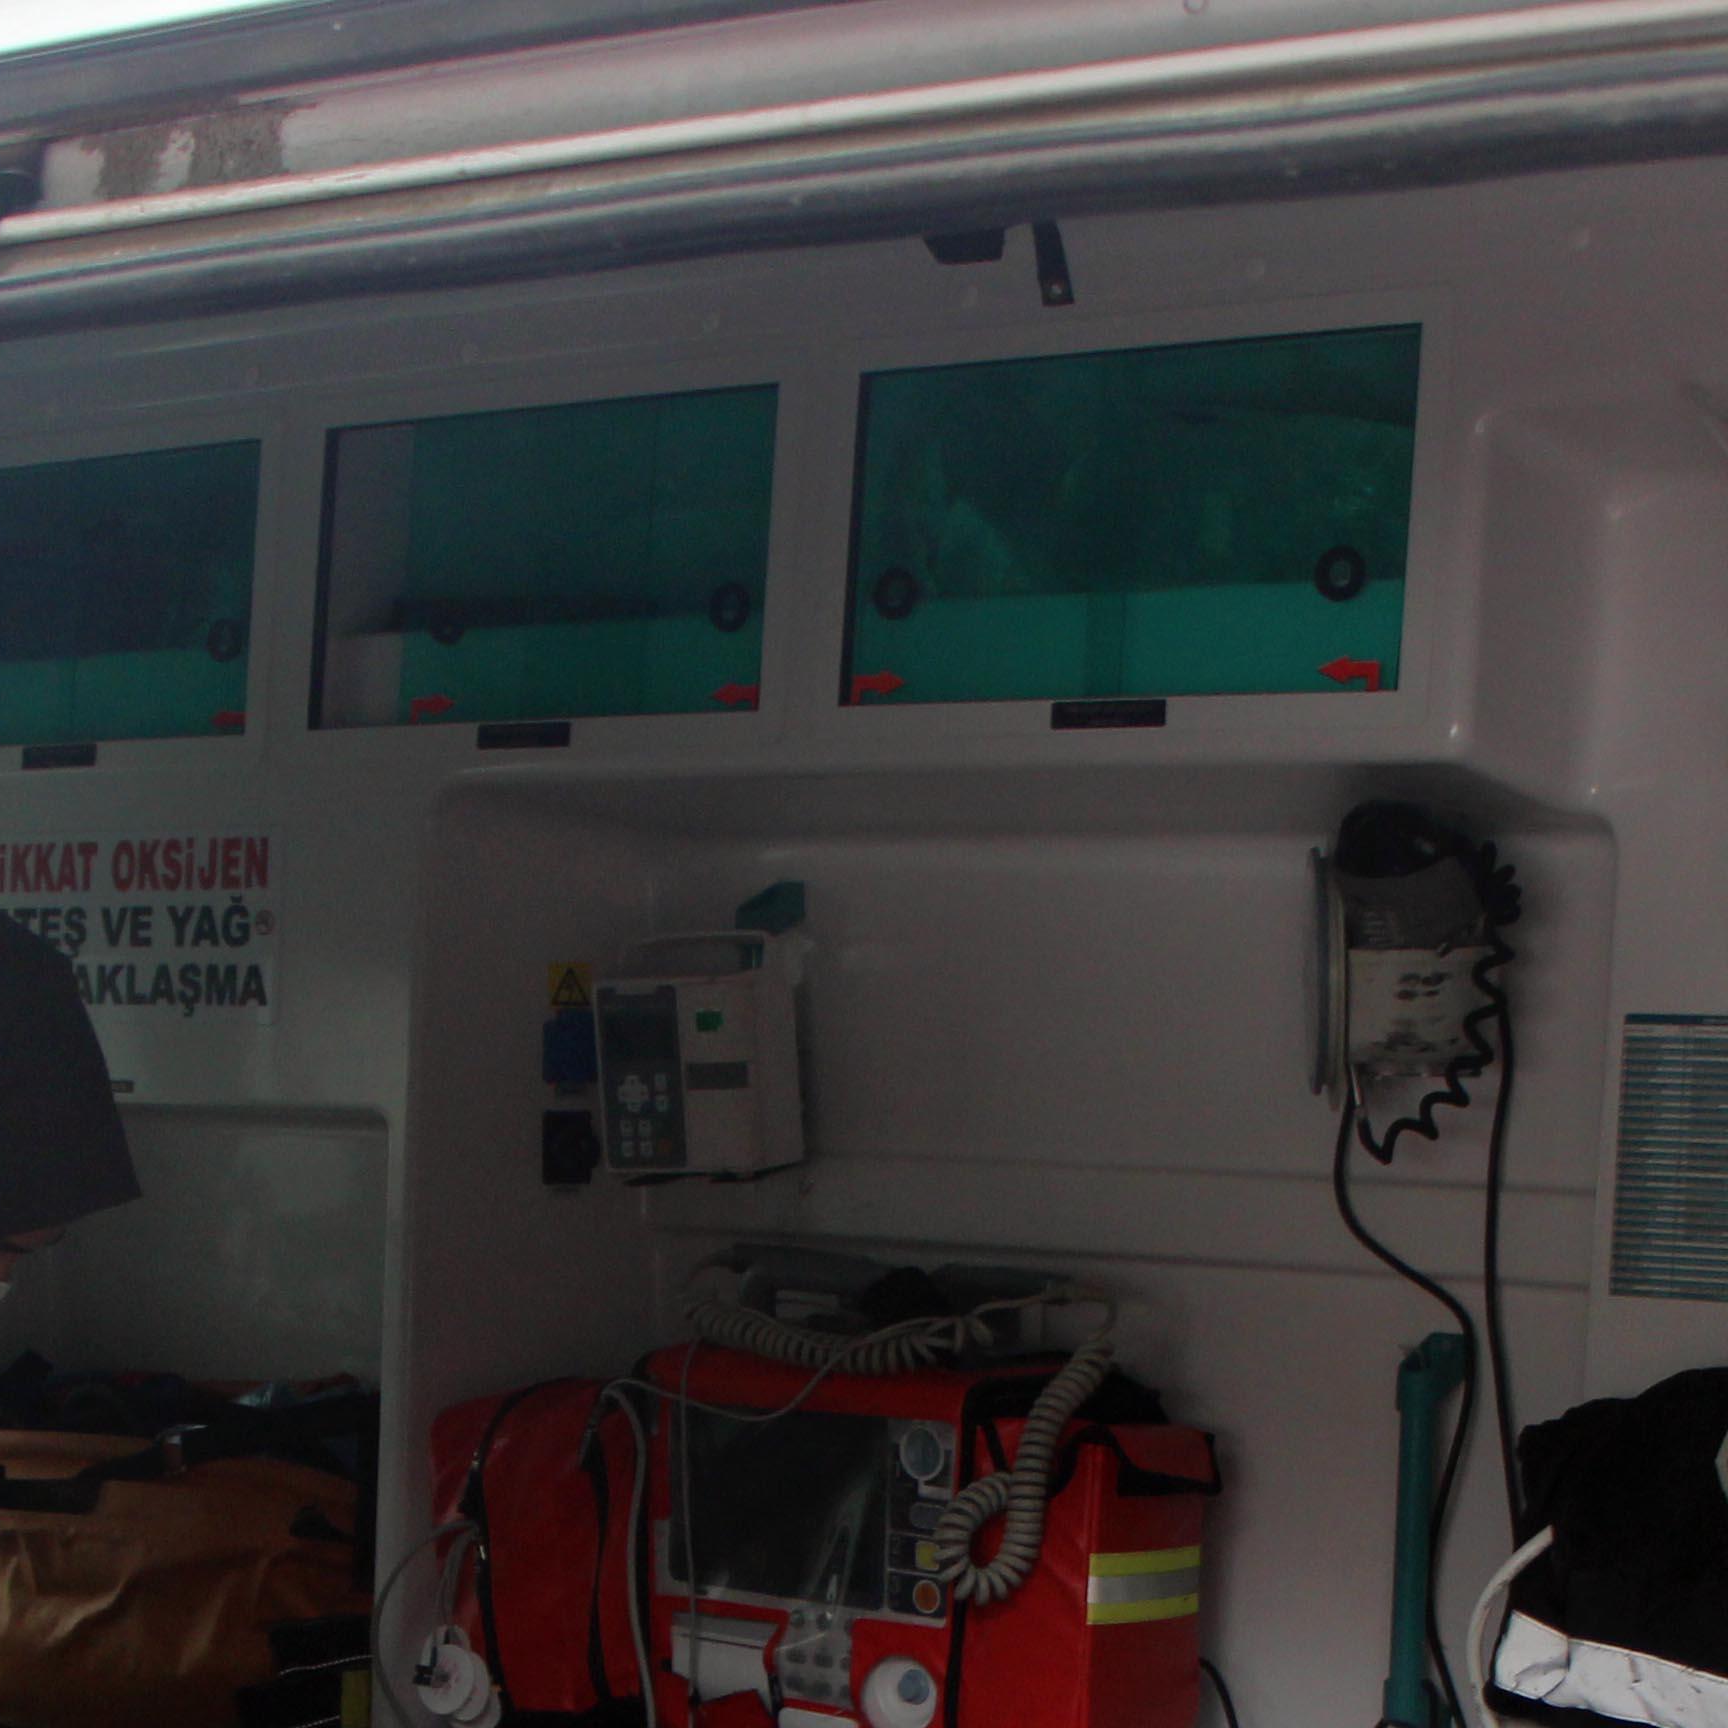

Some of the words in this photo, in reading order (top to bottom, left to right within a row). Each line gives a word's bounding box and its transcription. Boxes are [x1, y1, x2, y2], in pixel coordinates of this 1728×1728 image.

[1, 907, 88, 957] TEŞ
[101, 906, 153, 948] VE
[166, 895, 250, 948] YAĞ
[75, 964, 268, 1018] AKLAŞMA
